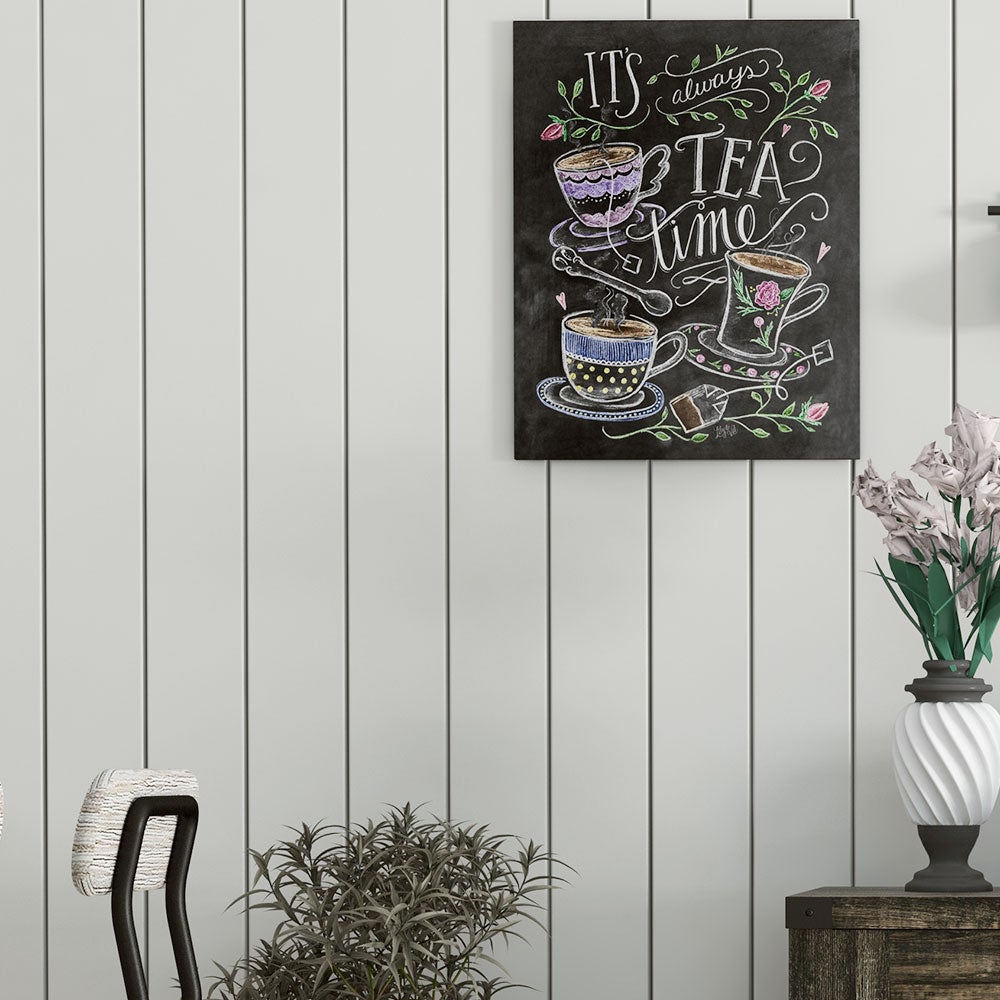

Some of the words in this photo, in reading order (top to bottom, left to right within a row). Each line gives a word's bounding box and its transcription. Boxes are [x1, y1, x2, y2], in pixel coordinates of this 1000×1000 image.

[584, 47, 643, 119] IT'S
[672, 59, 770, 105] always
[674, 123, 822, 205] TEA
[626, 195, 816, 283] time
